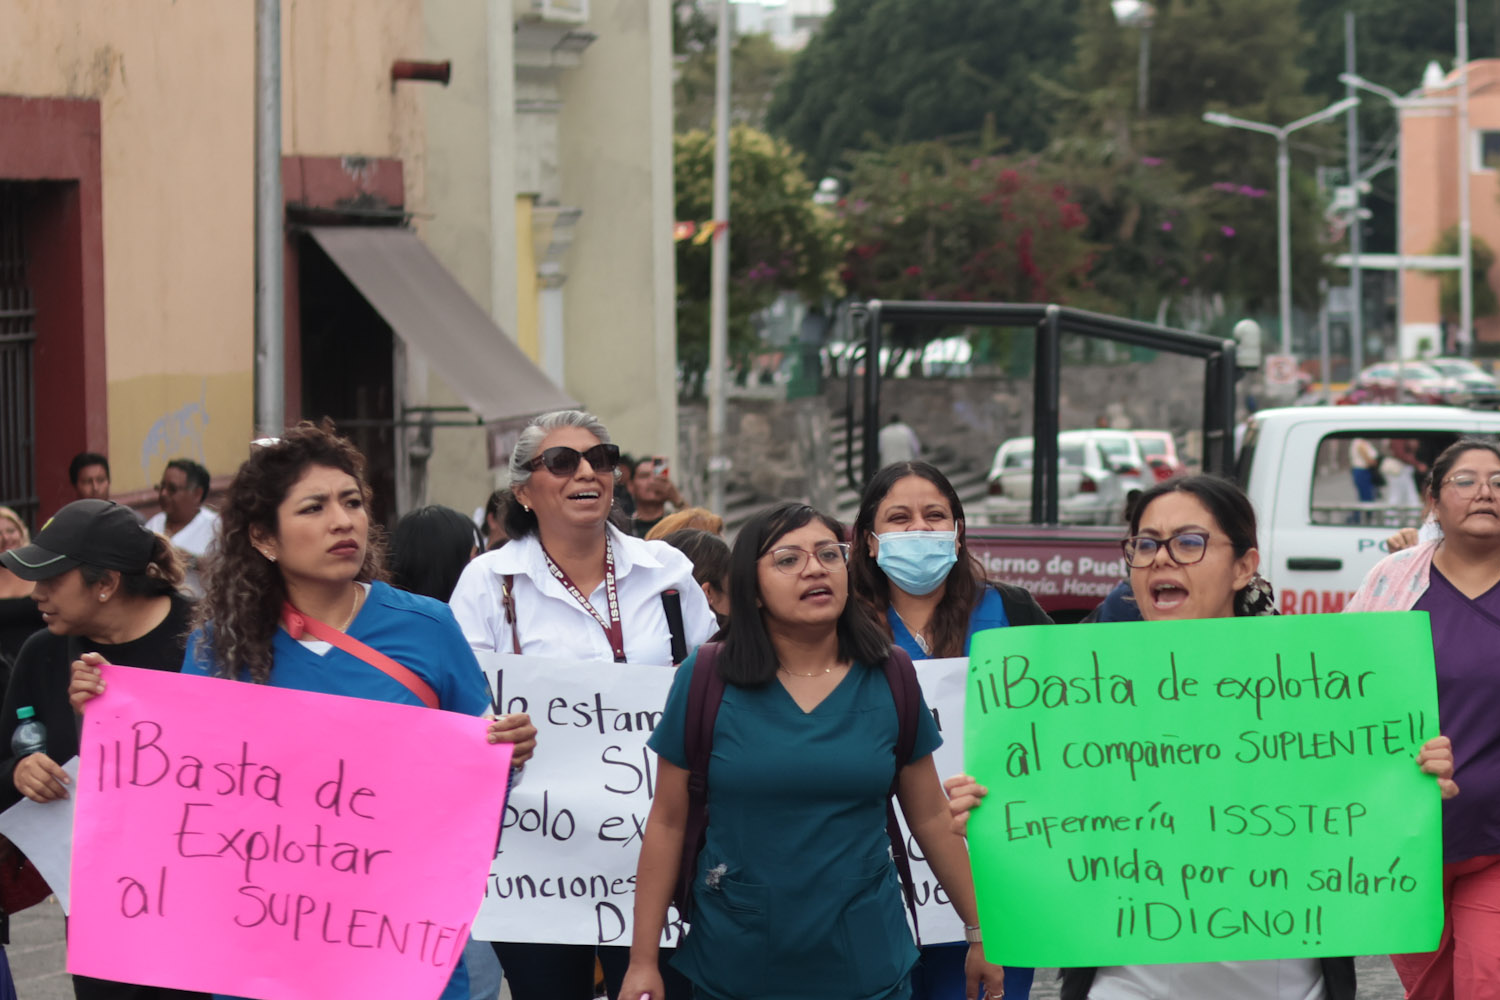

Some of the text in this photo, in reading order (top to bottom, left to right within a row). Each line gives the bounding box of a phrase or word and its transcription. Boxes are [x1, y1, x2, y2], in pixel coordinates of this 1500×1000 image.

[1046, 554, 1073, 575] de
[606, 572, 621, 622] ISSSTEP
[1281, 588, 1357, 615] BOM
[484, 668, 528, 715] No
[1157, 651, 1199, 702] de
[1215, 651, 1377, 721] explotar
[1005, 722, 1042, 777] al
[1062, 733, 1222, 781] compañero
[314, 758, 377, 820] de
[173, 802, 393, 883] Explotar
[1004, 800, 1367, 849] Enfermería ISSSTEP
[117, 865, 167, 918] al
[1067, 848, 1164, 886] unida
[1181, 862, 1235, 900] por
[1249, 866, 1289, 890] un
